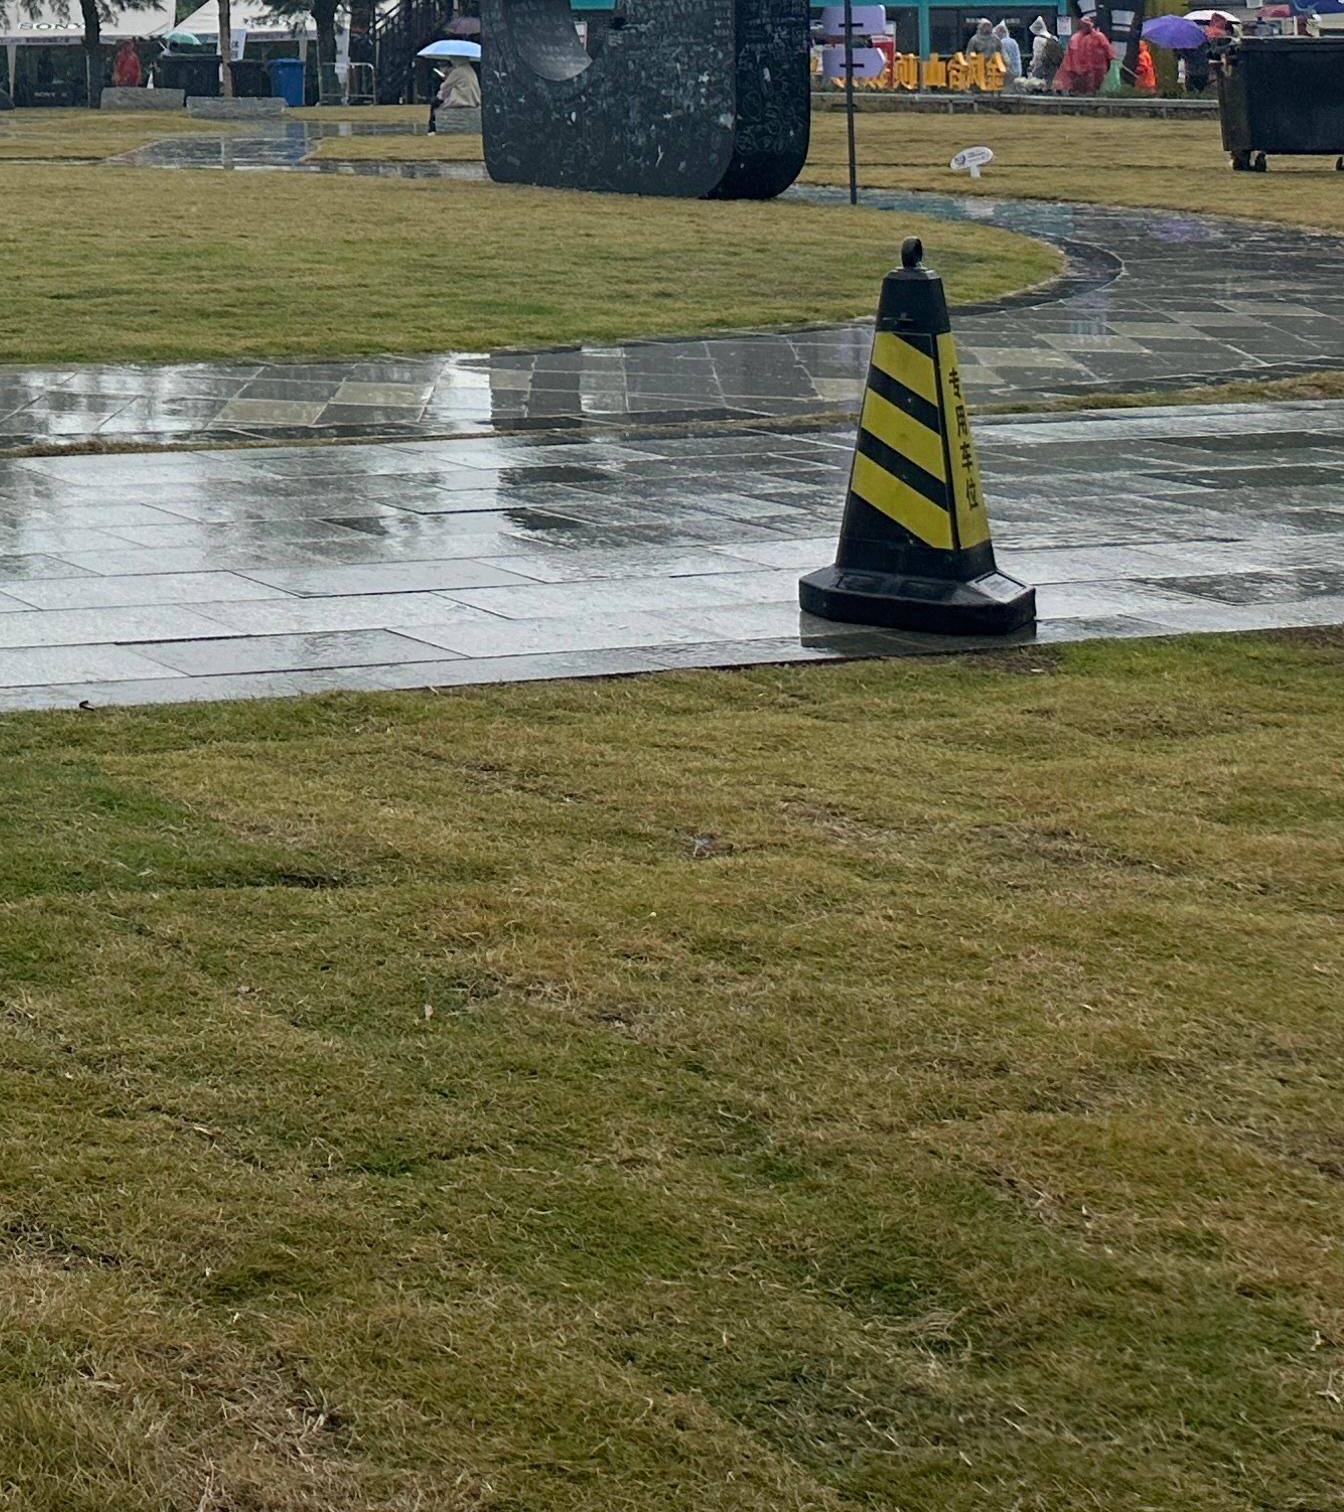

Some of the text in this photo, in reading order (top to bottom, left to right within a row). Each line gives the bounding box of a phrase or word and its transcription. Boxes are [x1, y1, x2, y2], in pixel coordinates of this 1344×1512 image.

[20, 22, 83, 31] SONY
[948, 367, 979, 511] 专用车位
